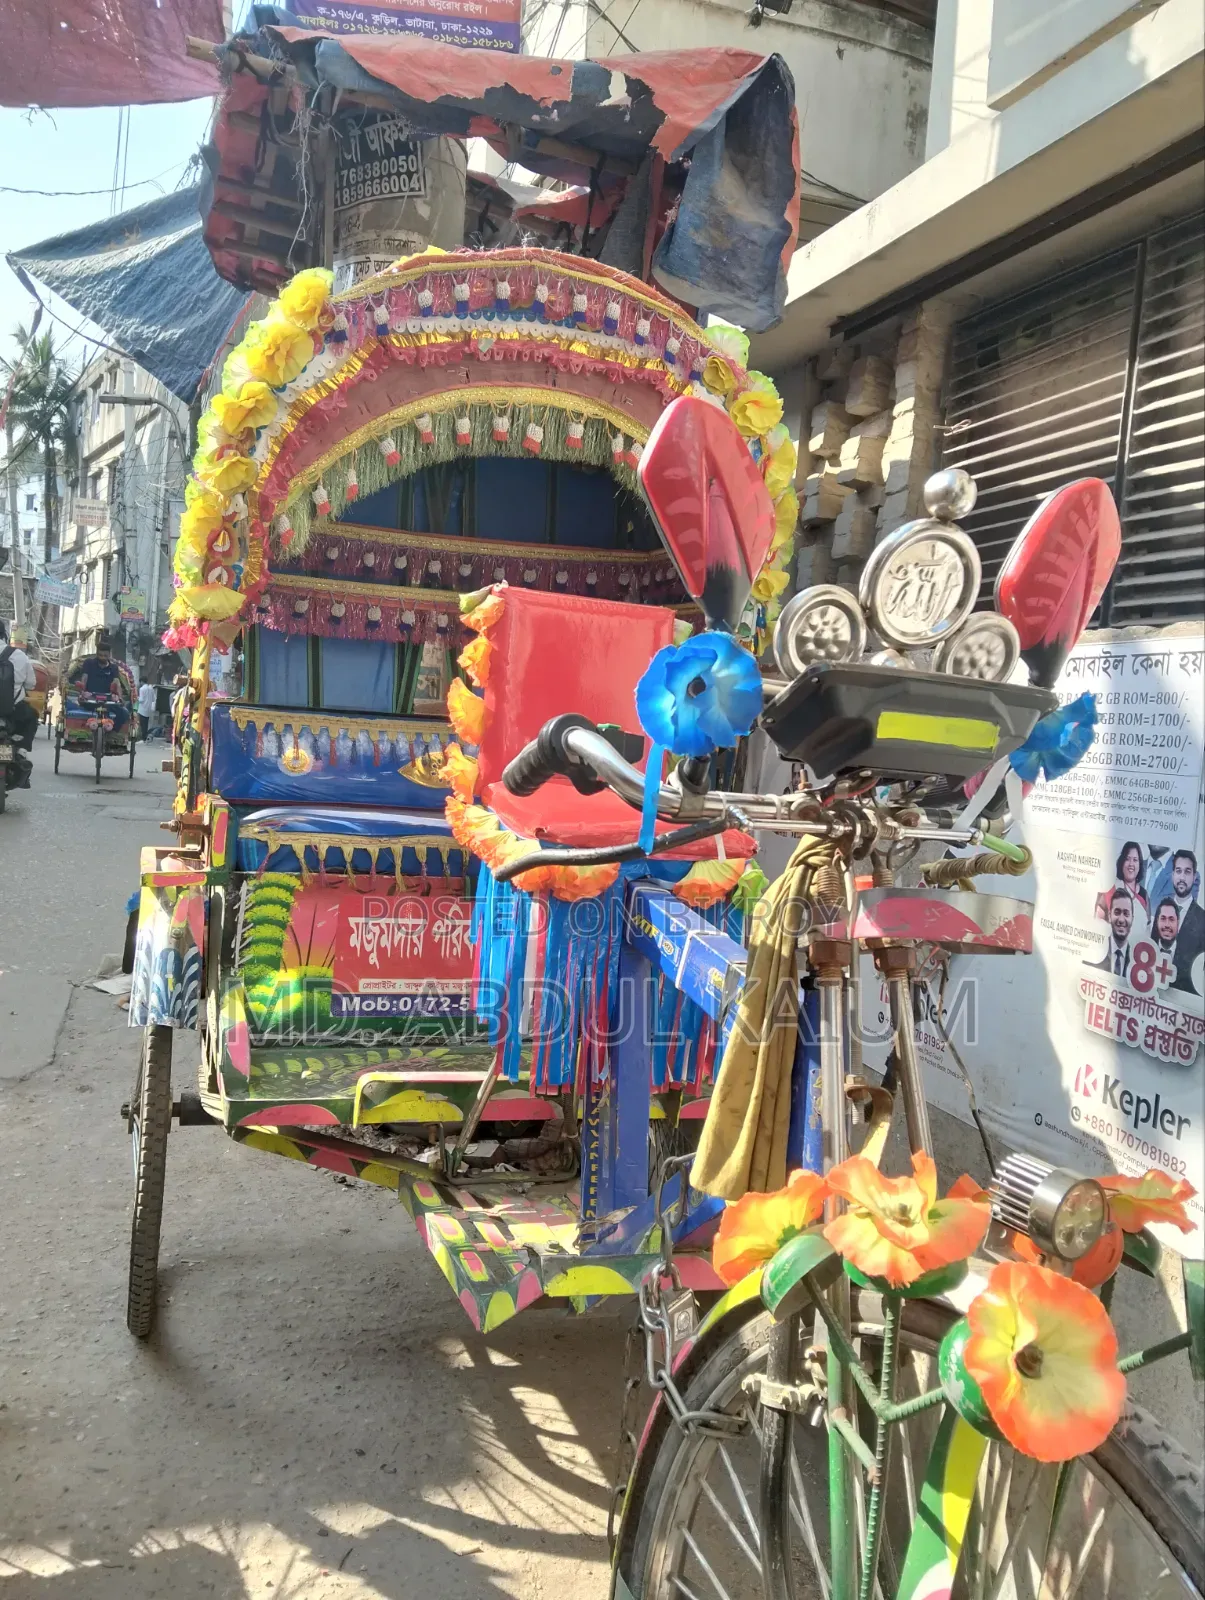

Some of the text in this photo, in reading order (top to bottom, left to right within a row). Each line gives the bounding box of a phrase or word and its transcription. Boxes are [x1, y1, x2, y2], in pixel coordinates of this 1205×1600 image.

[404, 17, 438, 32] ভাটারা,
[441, 21, 493, 36] ঢাকা-১২২৯
[1066, 648, 1127, 679] মোবাইল
[1131, 650, 1173, 676] কেনা
[1106, 692, 1120, 705] GB
[1123, 690, 1189, 708] ROM=800/-
[1117, 712, 1191, 731] ROM=1700/-
[1102, 732, 1117, 745] GB
[1119, 732, 1192, 752] ROM=2200/-
[1115, 753, 1188, 774] ROM=2700/-
[1105, 775, 1128, 787] EMMC
[1104, 789, 1127, 802] EMMC
[1124, 816, 1179, 832] 01747-779600
[1078, 855, 1102, 869] NAHREEN
[348, 914, 428, 971] মজুমদার
[1056, 922, 1074, 936] AHMED
[1074, 927, 1106, 945] CHOWDHURY
[1130, 941, 1173, 993] 8+
[1080, 977, 1107, 1001] ব্যান্ড
[1109, 989, 1179, 1027] এক্সপার্টদের
[1087, 1002, 1195, 1061] IELTS প্রস্তুতি
[1102, 1073, 1192, 1141] Kepler
[1084, 1113, 1187, 1177] +880 1707081982
[1122, 1152, 1149, 1171] Complex
